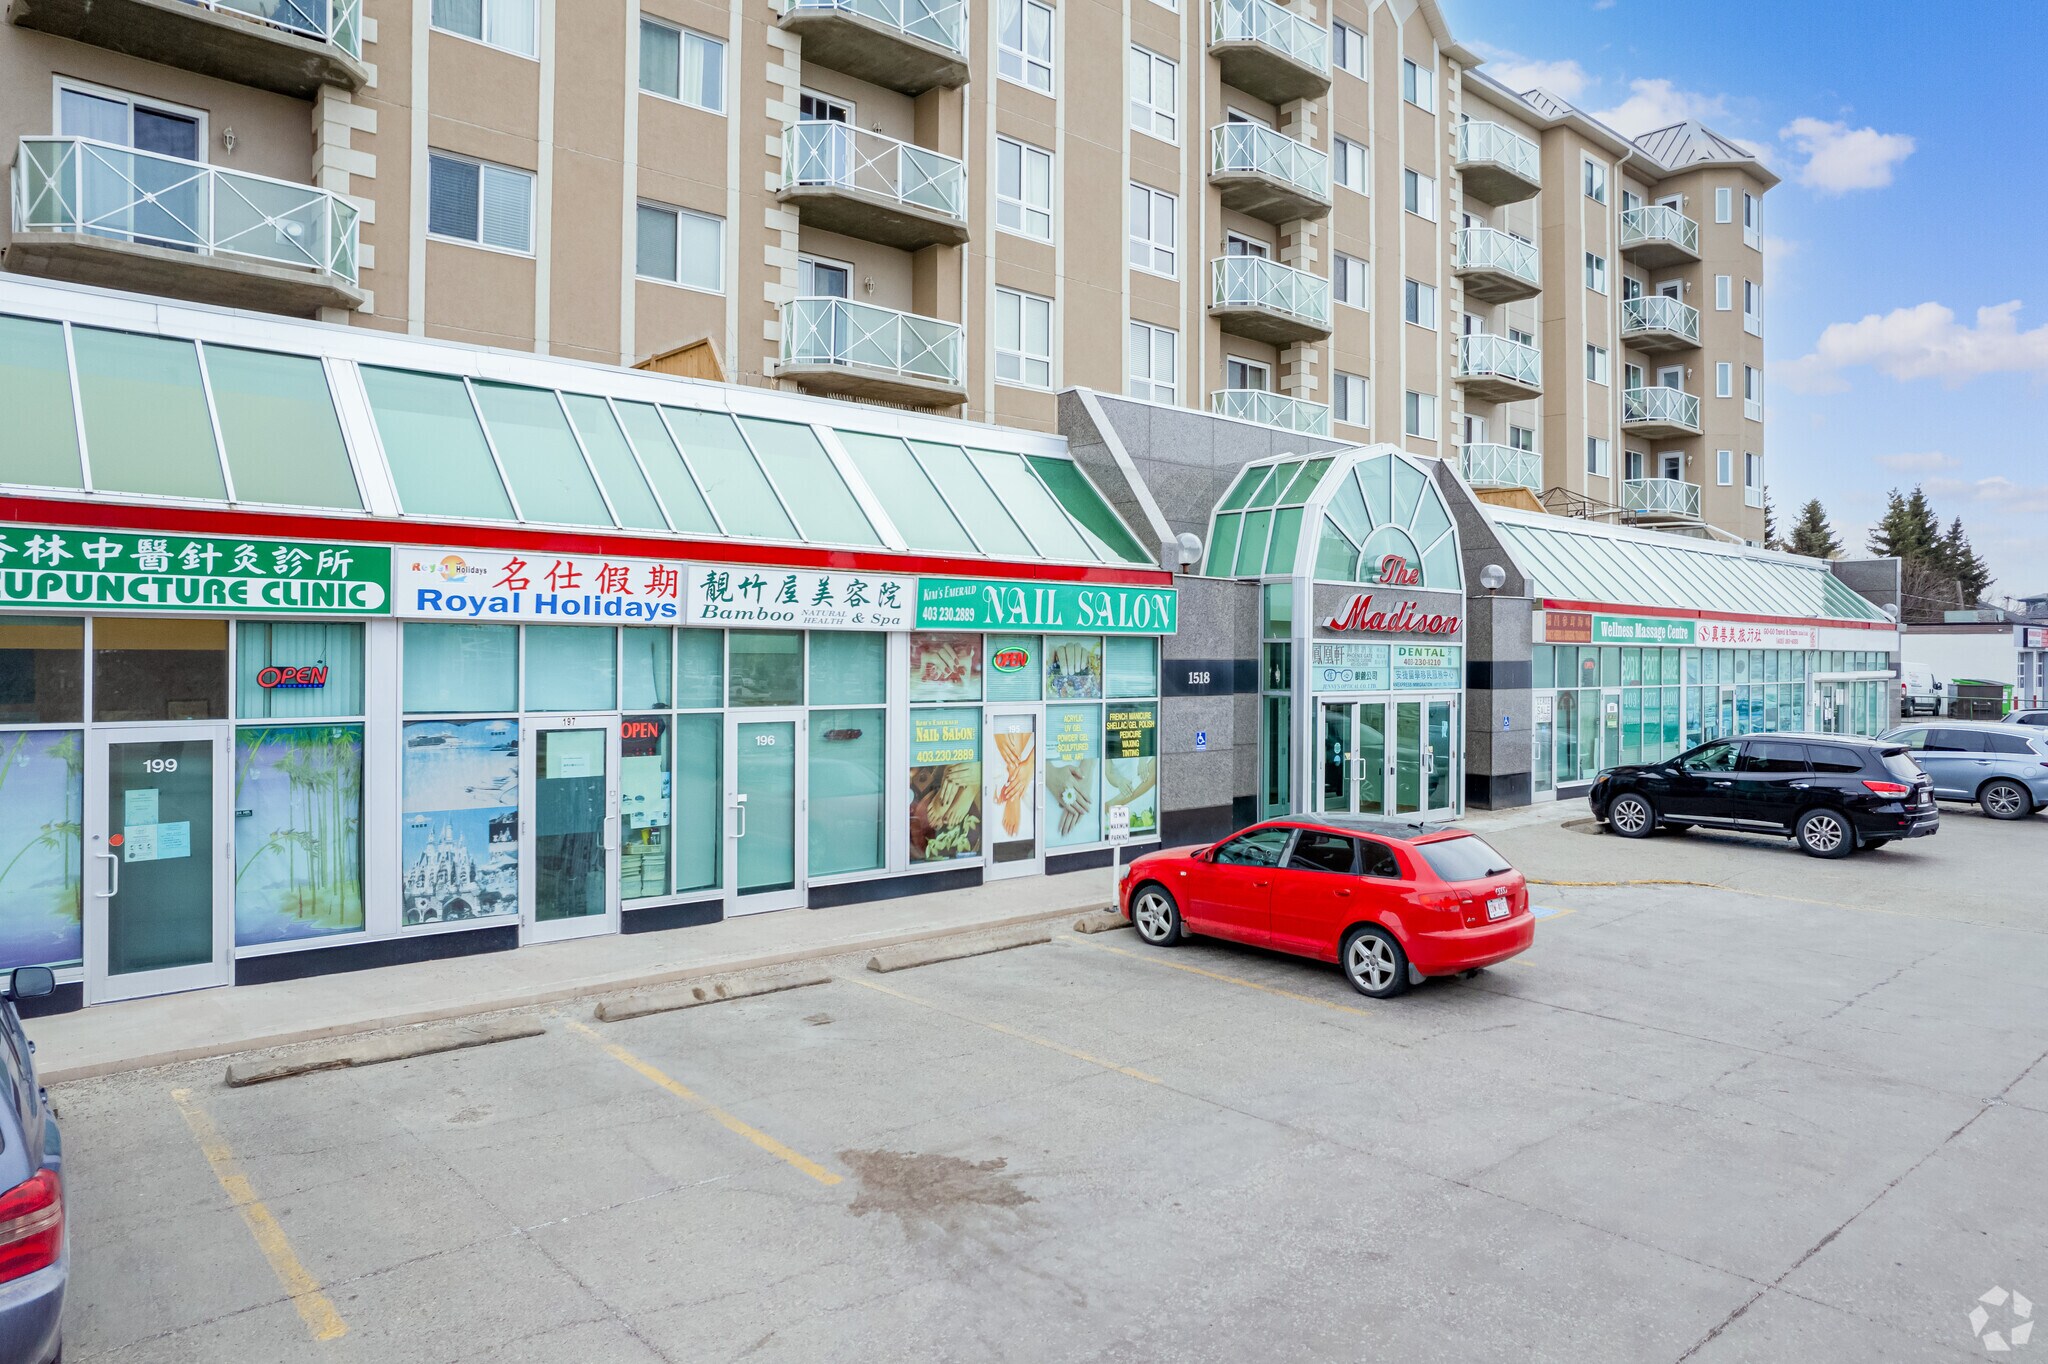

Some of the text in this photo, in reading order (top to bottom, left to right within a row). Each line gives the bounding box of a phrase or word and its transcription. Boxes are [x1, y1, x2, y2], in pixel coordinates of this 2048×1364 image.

[456, 565, 488, 575] Holidays
[1378, 554, 1420, 585] The
[492, 556, 679, 599] 名仕假期
[0, 571, 366, 608] UPUNCTURE CLINIC
[700, 569, 902, 609] 靚竹屋美容院
[417, 589, 677, 621] Royal Holidays
[982, 585, 1172, 629] NAIL SALON
[700, 604, 901, 627] Bamboo & Spa
[801, 608, 847, 618] NATURAL
[922, 606, 975, 622] 403 230.2889
[1327, 593, 1463, 635] Madison
[803, 616, 845, 625] HEALTH
[1600, 621, 1634, 638] Wellness
[1635, 623, 1666, 642] Massage
[1667, 624, 1689, 639] Centre
[1398, 647, 1446, 657] DENTAL
[995, 652, 1028, 668] OPEN
[256, 666, 329, 688] OPEN
[1188, 671, 1211, 684] 1518
[562, 718, 576, 726] 197
[1063, 714, 1084, 723] ACRYLIC
[1109, 712, 1152, 721] FRENCH MANICURE
[621, 722, 659, 739] OPEN
[1139, 720, 1155, 728] POLISH
[755, 735, 775, 746] 196
[916, 726, 940, 742] NAIL
[942, 726, 974, 742] SALON
[1057, 734, 1078, 743] POWDER
[1119, 730, 1142, 739] PEDICURE
[1057, 743, 1089, 752] SCULPTURED
[1121, 739, 1140, 748] WAXING
[916, 749, 974, 763] 403.230.2889
[1121, 749, 1140, 758] TINTING
[142, 758, 178, 774] 199
